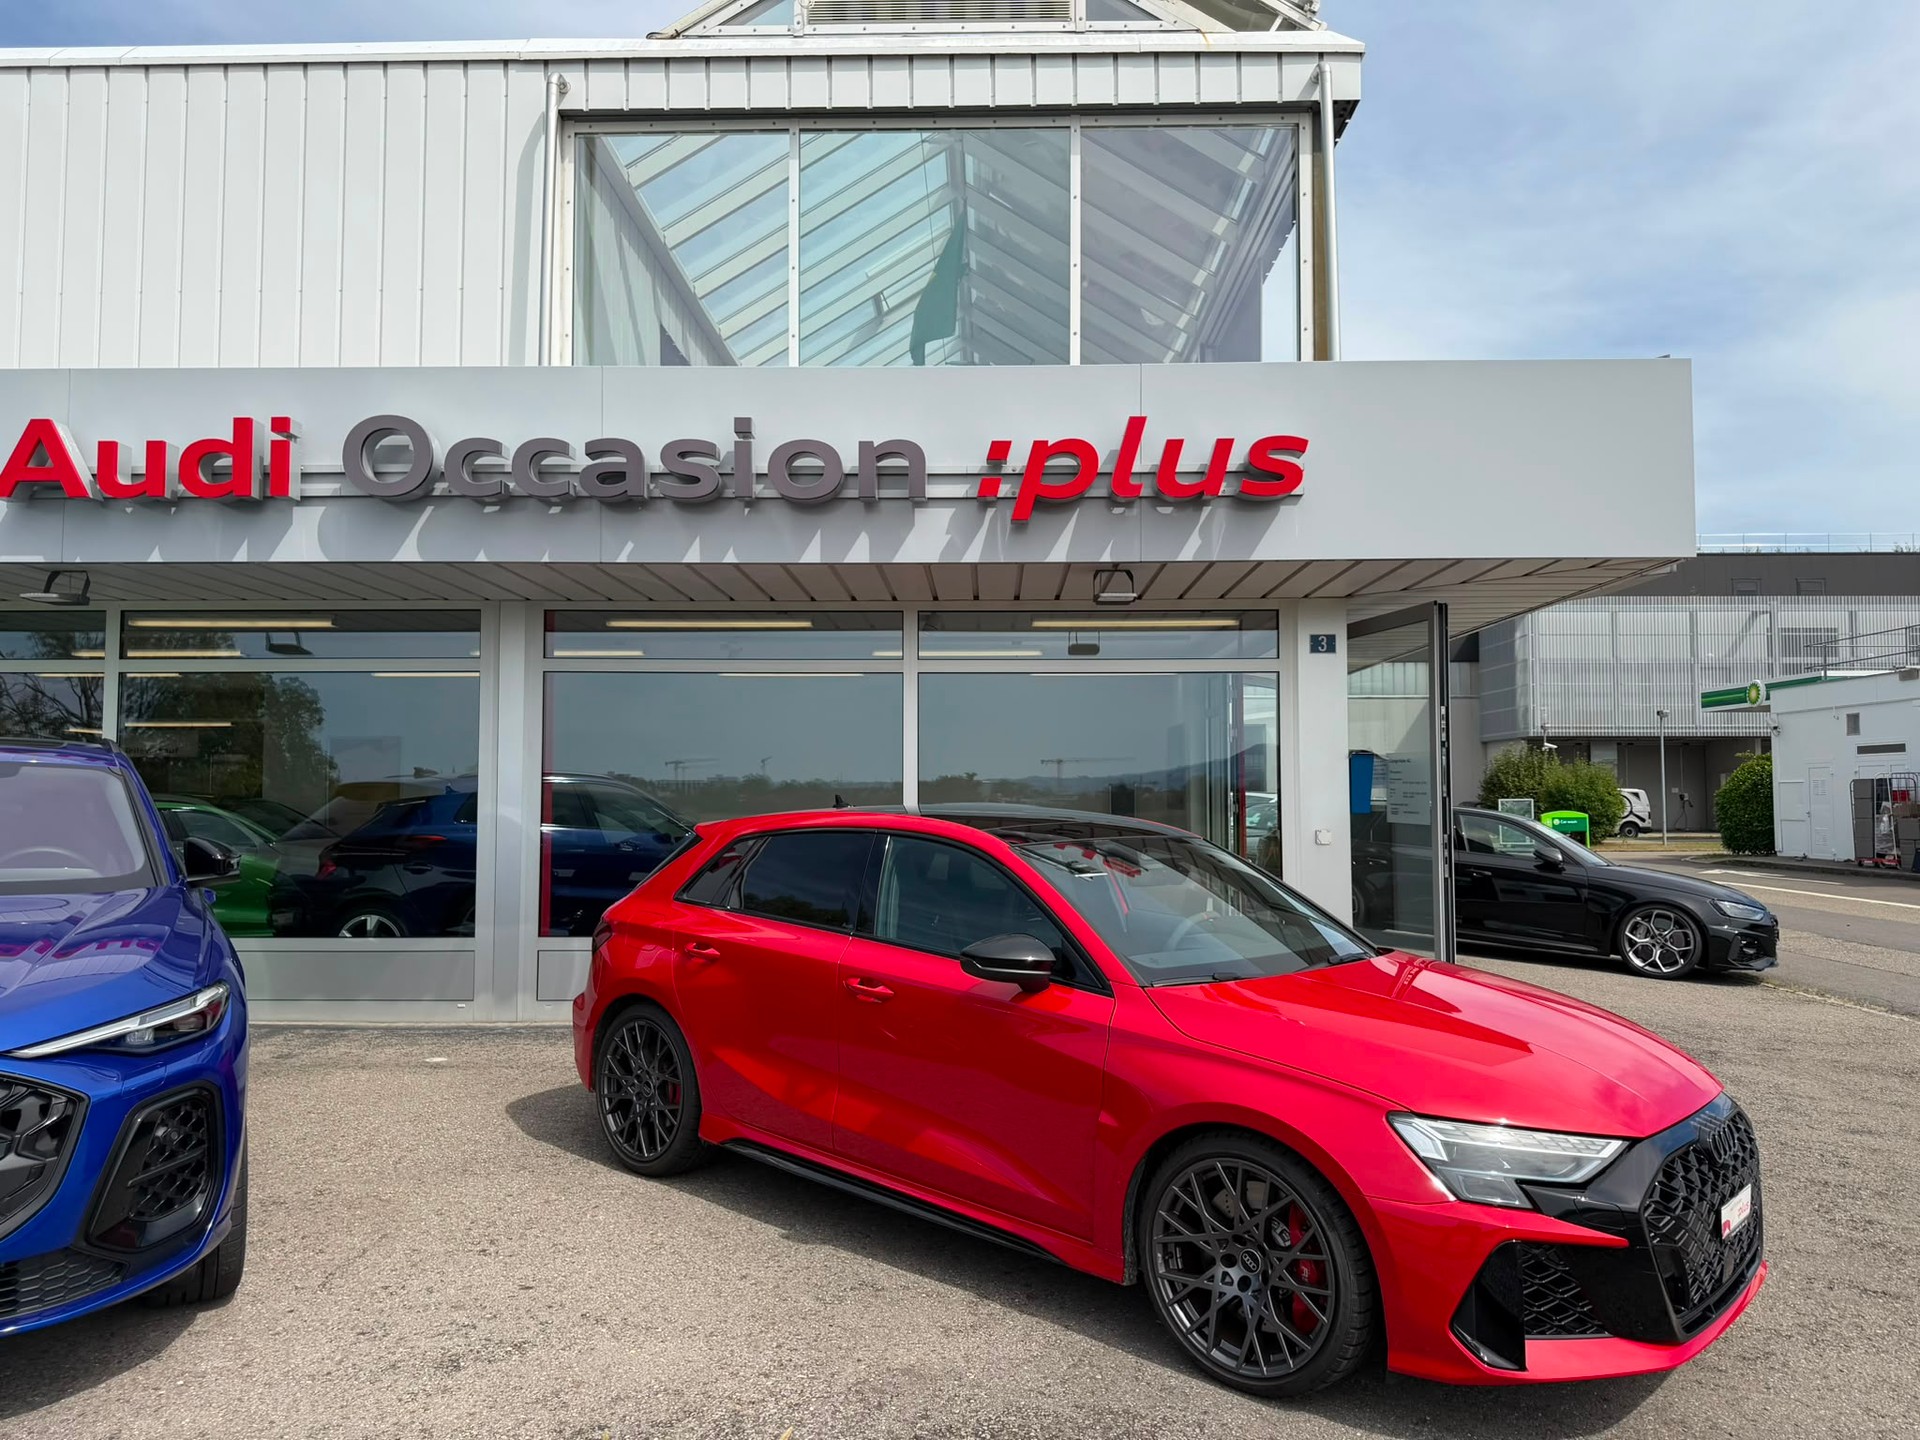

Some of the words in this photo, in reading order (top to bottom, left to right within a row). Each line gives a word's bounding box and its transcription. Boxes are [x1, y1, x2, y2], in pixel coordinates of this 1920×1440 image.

[0, 415, 300, 501] Audi
[342, 414, 927, 503] Occasion
[976, 415, 1310, 523] :plus
[1317, 635, 1328, 653] 3
